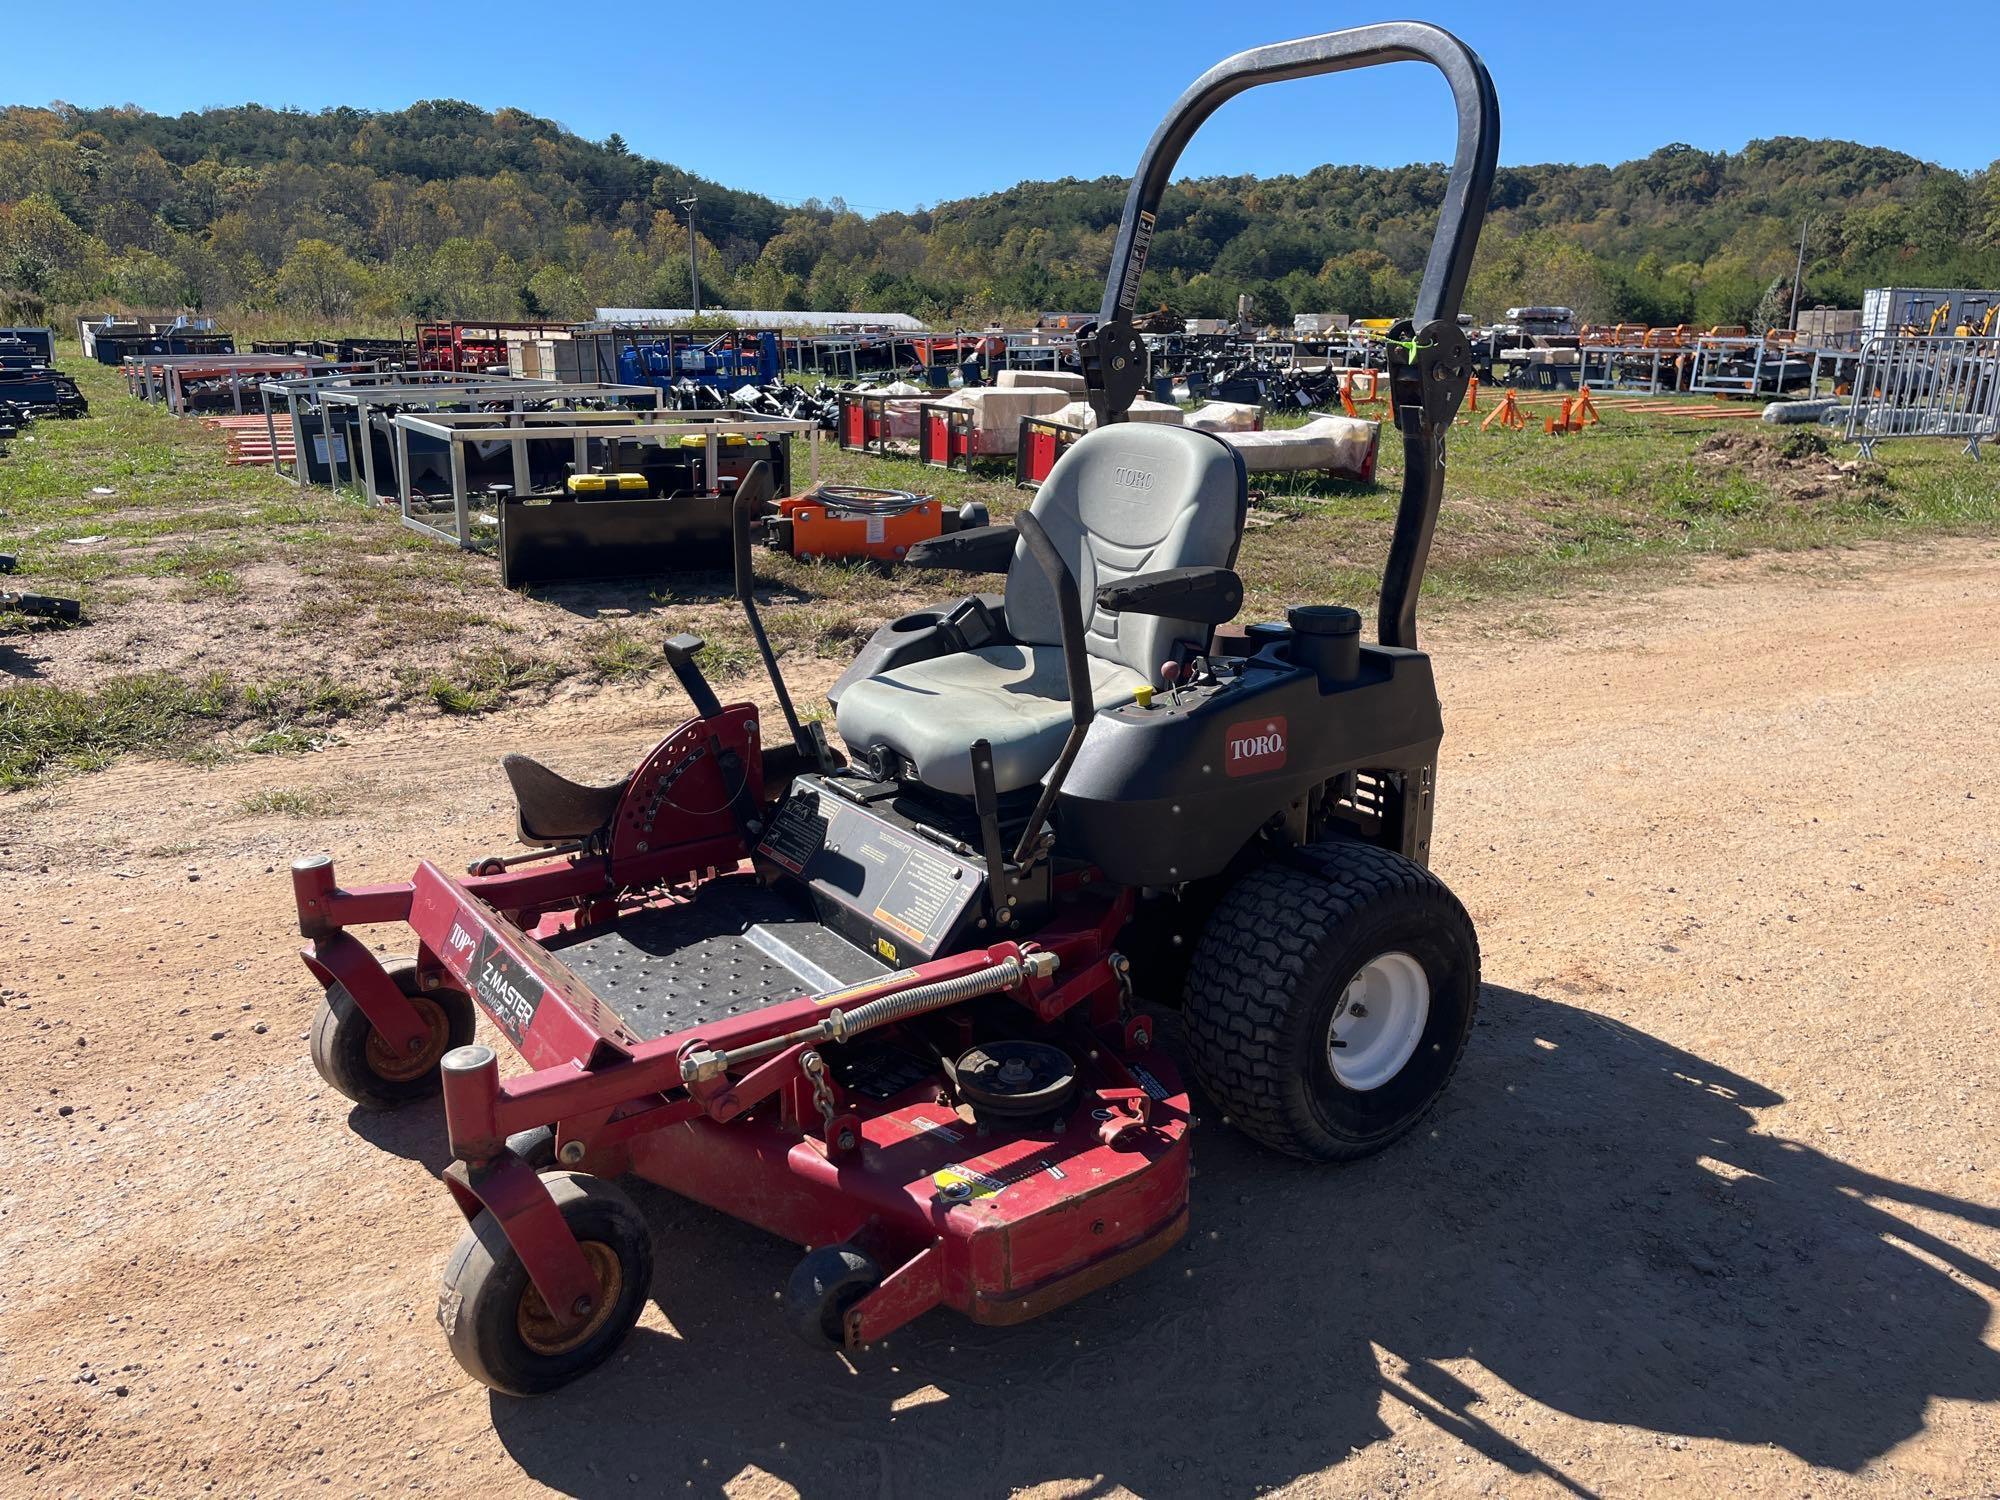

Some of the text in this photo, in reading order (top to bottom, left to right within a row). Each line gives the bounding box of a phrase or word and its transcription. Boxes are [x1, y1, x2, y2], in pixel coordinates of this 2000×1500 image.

[1114, 467, 1153, 491] TORO
[1231, 733, 1283, 760] TORO
[482, 961, 535, 1025] Z MASTER
